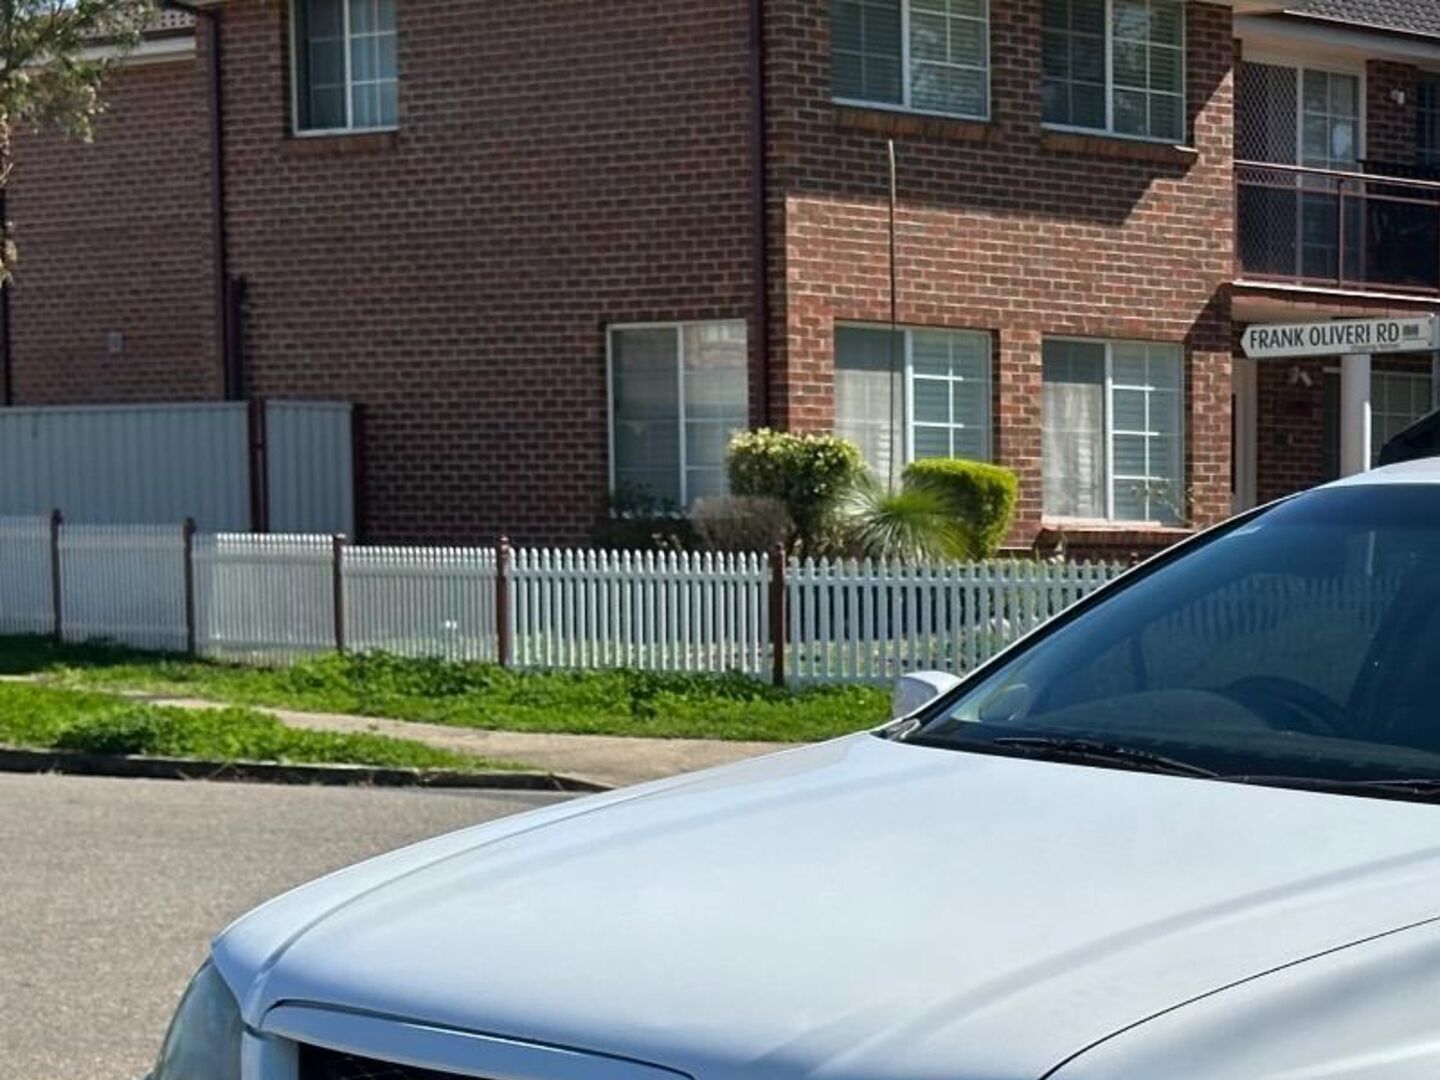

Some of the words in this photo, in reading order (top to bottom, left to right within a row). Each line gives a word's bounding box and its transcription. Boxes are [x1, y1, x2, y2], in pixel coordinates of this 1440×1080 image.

[1250, 327, 1304, 350] FRANK
[1310, 325, 1371, 347] OLIVERI
[1376, 322, 1399, 342] RD
